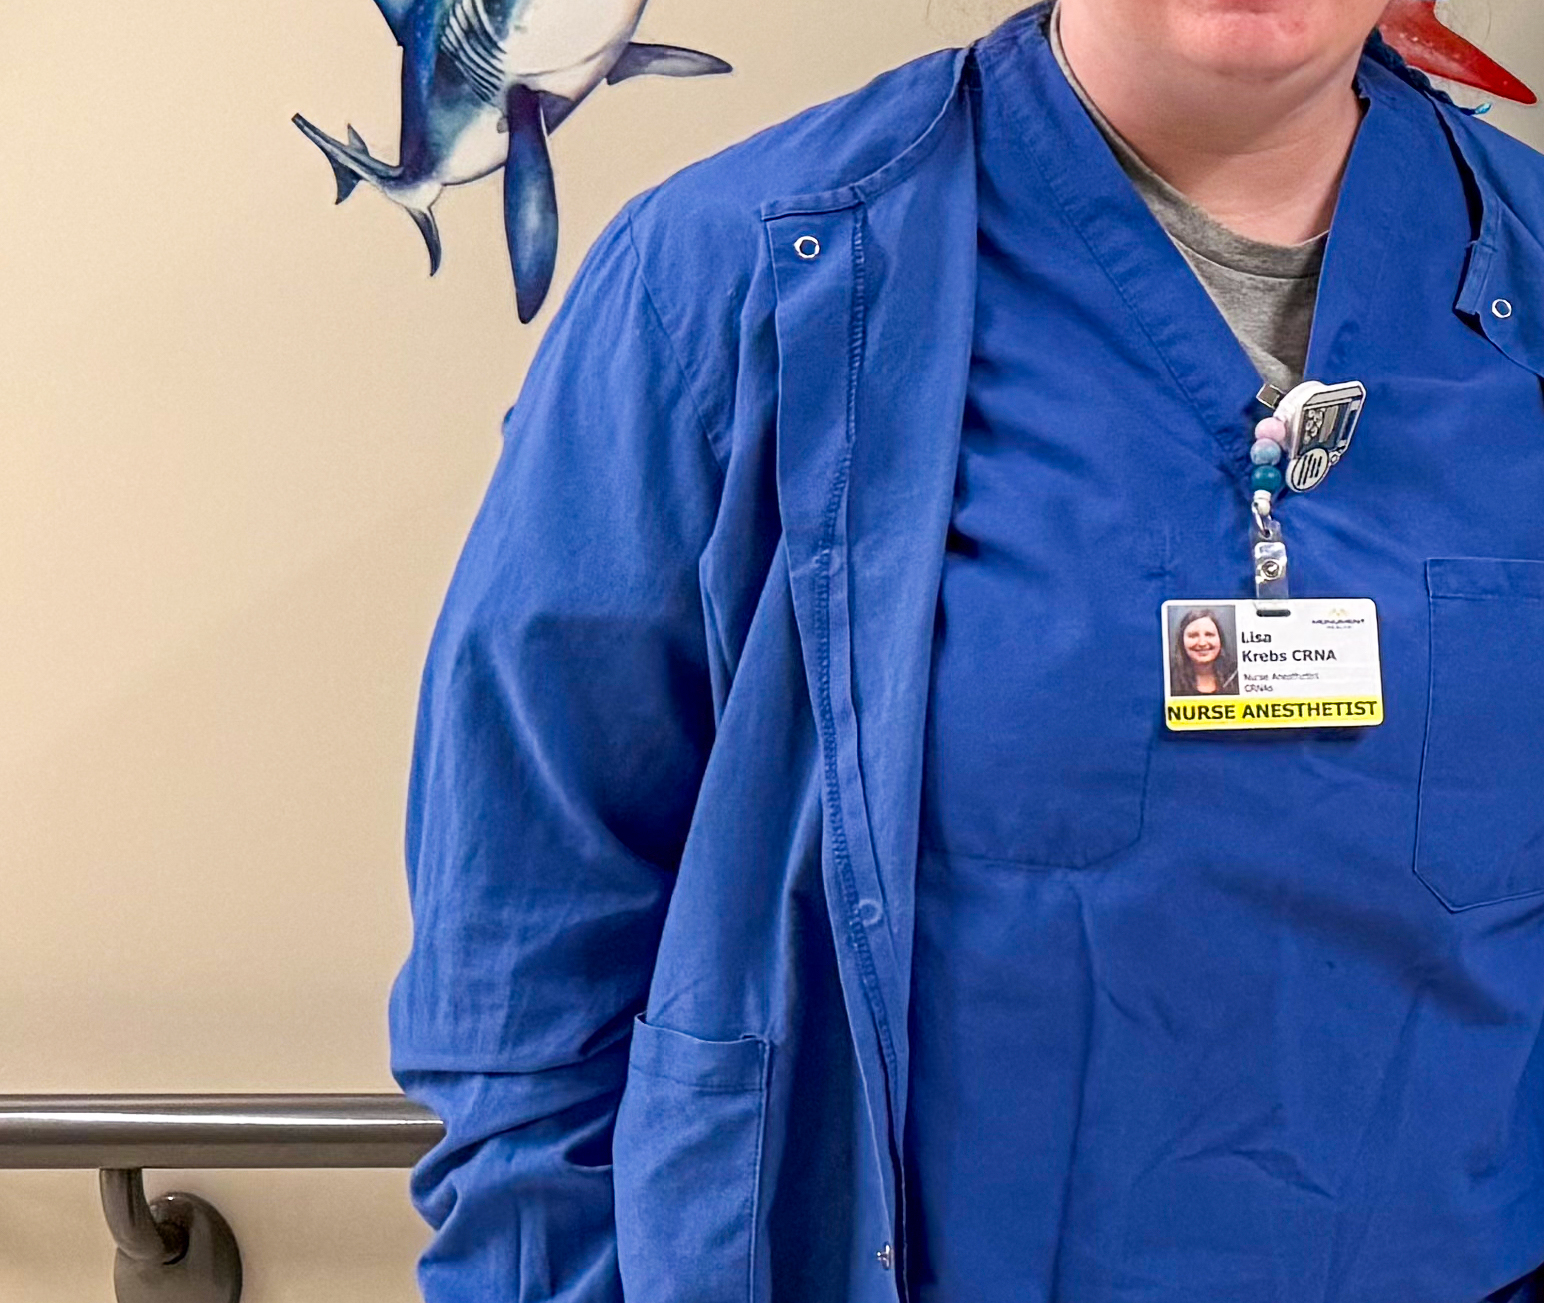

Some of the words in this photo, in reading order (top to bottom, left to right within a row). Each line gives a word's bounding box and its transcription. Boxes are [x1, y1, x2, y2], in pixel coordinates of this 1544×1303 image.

[1241, 631, 1272, 643] Lisa
[1242, 650, 1287, 662] Krebs
[1291, 649, 1337, 662] CRNA
[1168, 705, 1236, 721] NURSE
[1242, 700, 1377, 719] ANESTHETIST
